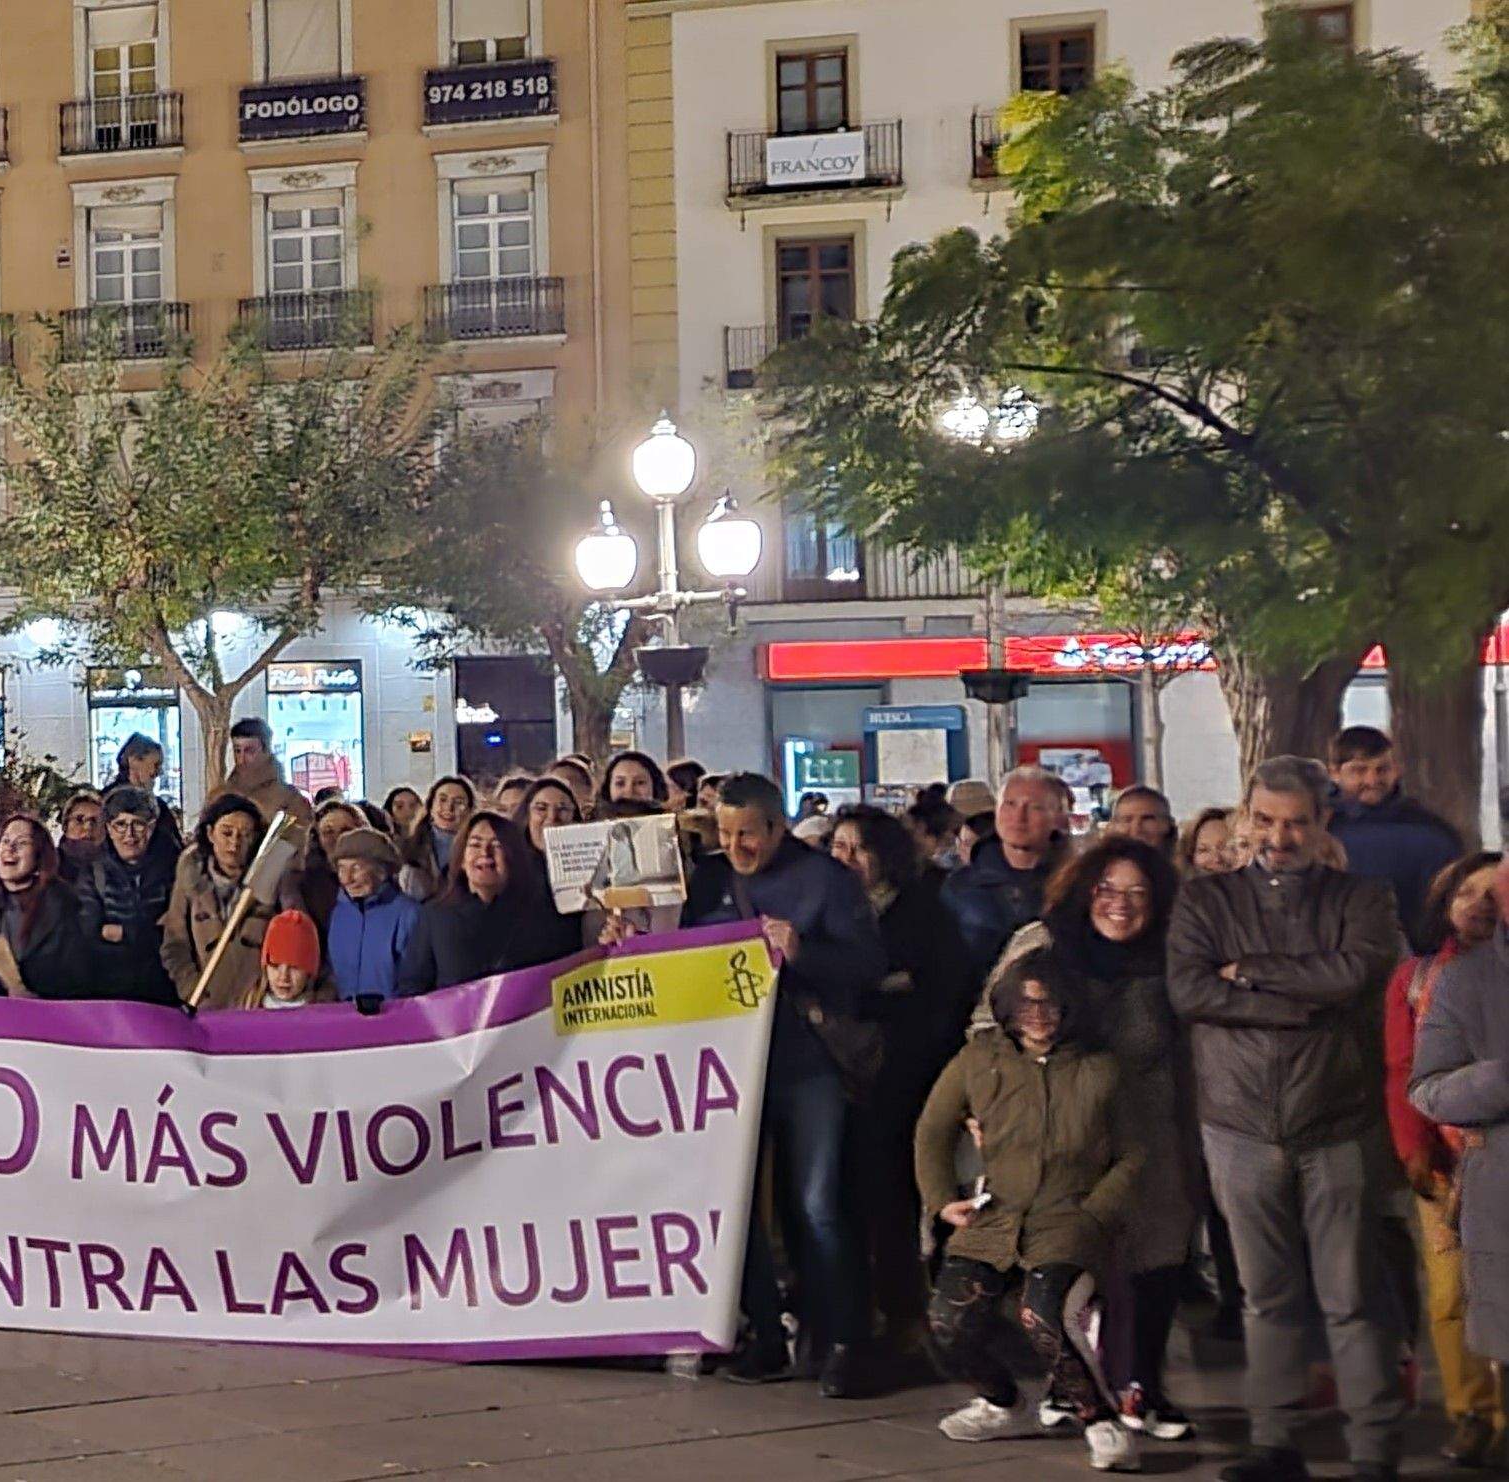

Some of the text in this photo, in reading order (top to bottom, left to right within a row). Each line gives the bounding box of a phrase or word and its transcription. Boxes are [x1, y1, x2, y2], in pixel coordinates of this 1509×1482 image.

[428, 76, 549, 104] 974 218 518
[243, 94, 359, 120] PODÓLOGO
[869, 711, 911, 723] HUESCA
[562, 967, 655, 1009] AMNISTÍA
[563, 1001, 658, 1027] INTERNACIONAL
[71, 1084, 248, 1187] MÁS
[266, 1047, 740, 1185] VIOLENCIA
[215, 1242, 380, 1315] LAS
[403, 1210, 722, 1312] MUJER
